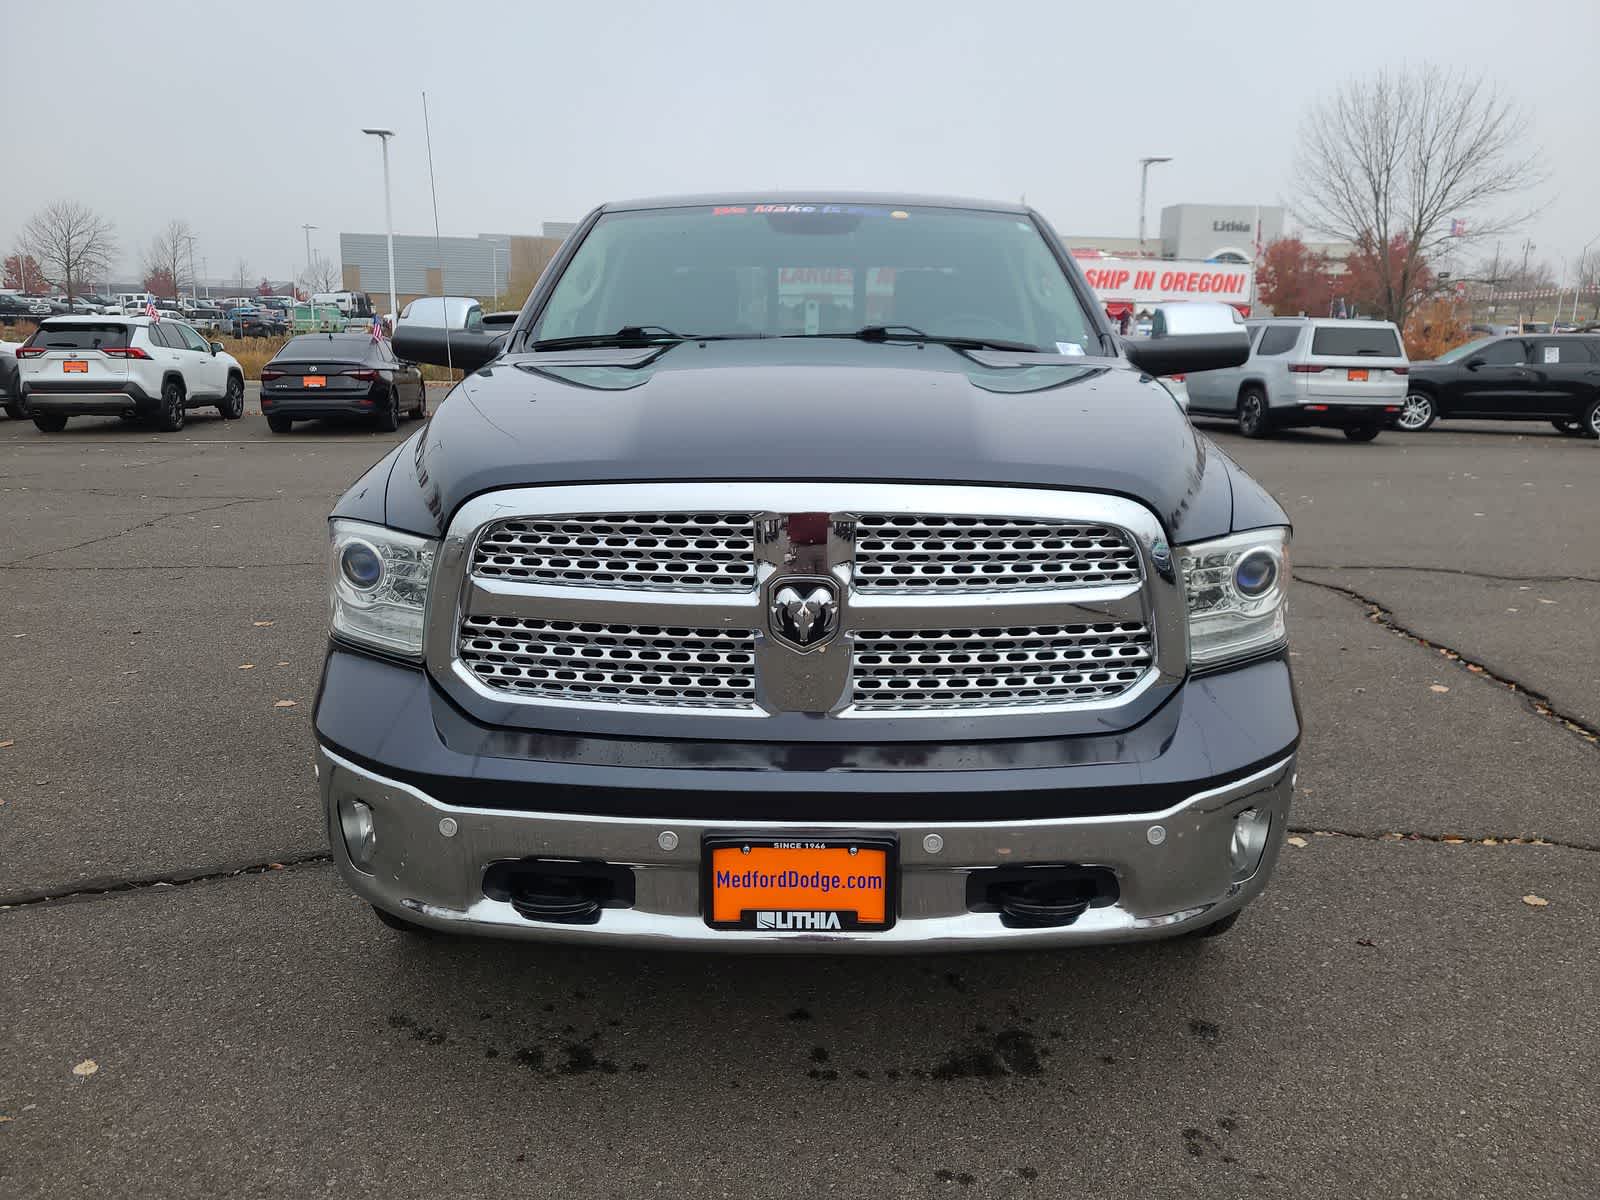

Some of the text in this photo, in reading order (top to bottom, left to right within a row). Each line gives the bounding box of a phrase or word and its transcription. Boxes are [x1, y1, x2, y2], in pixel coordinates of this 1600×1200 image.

[1212, 220, 1251, 233] Lithia
[1133, 270, 1155, 291] IN
[1160, 271, 1247, 294] OREGON!
[773, 842, 826, 850] SINCE 1946
[716, 870, 882, 892] MedfordDodge.com
[775, 911, 841, 929] LITHIA
